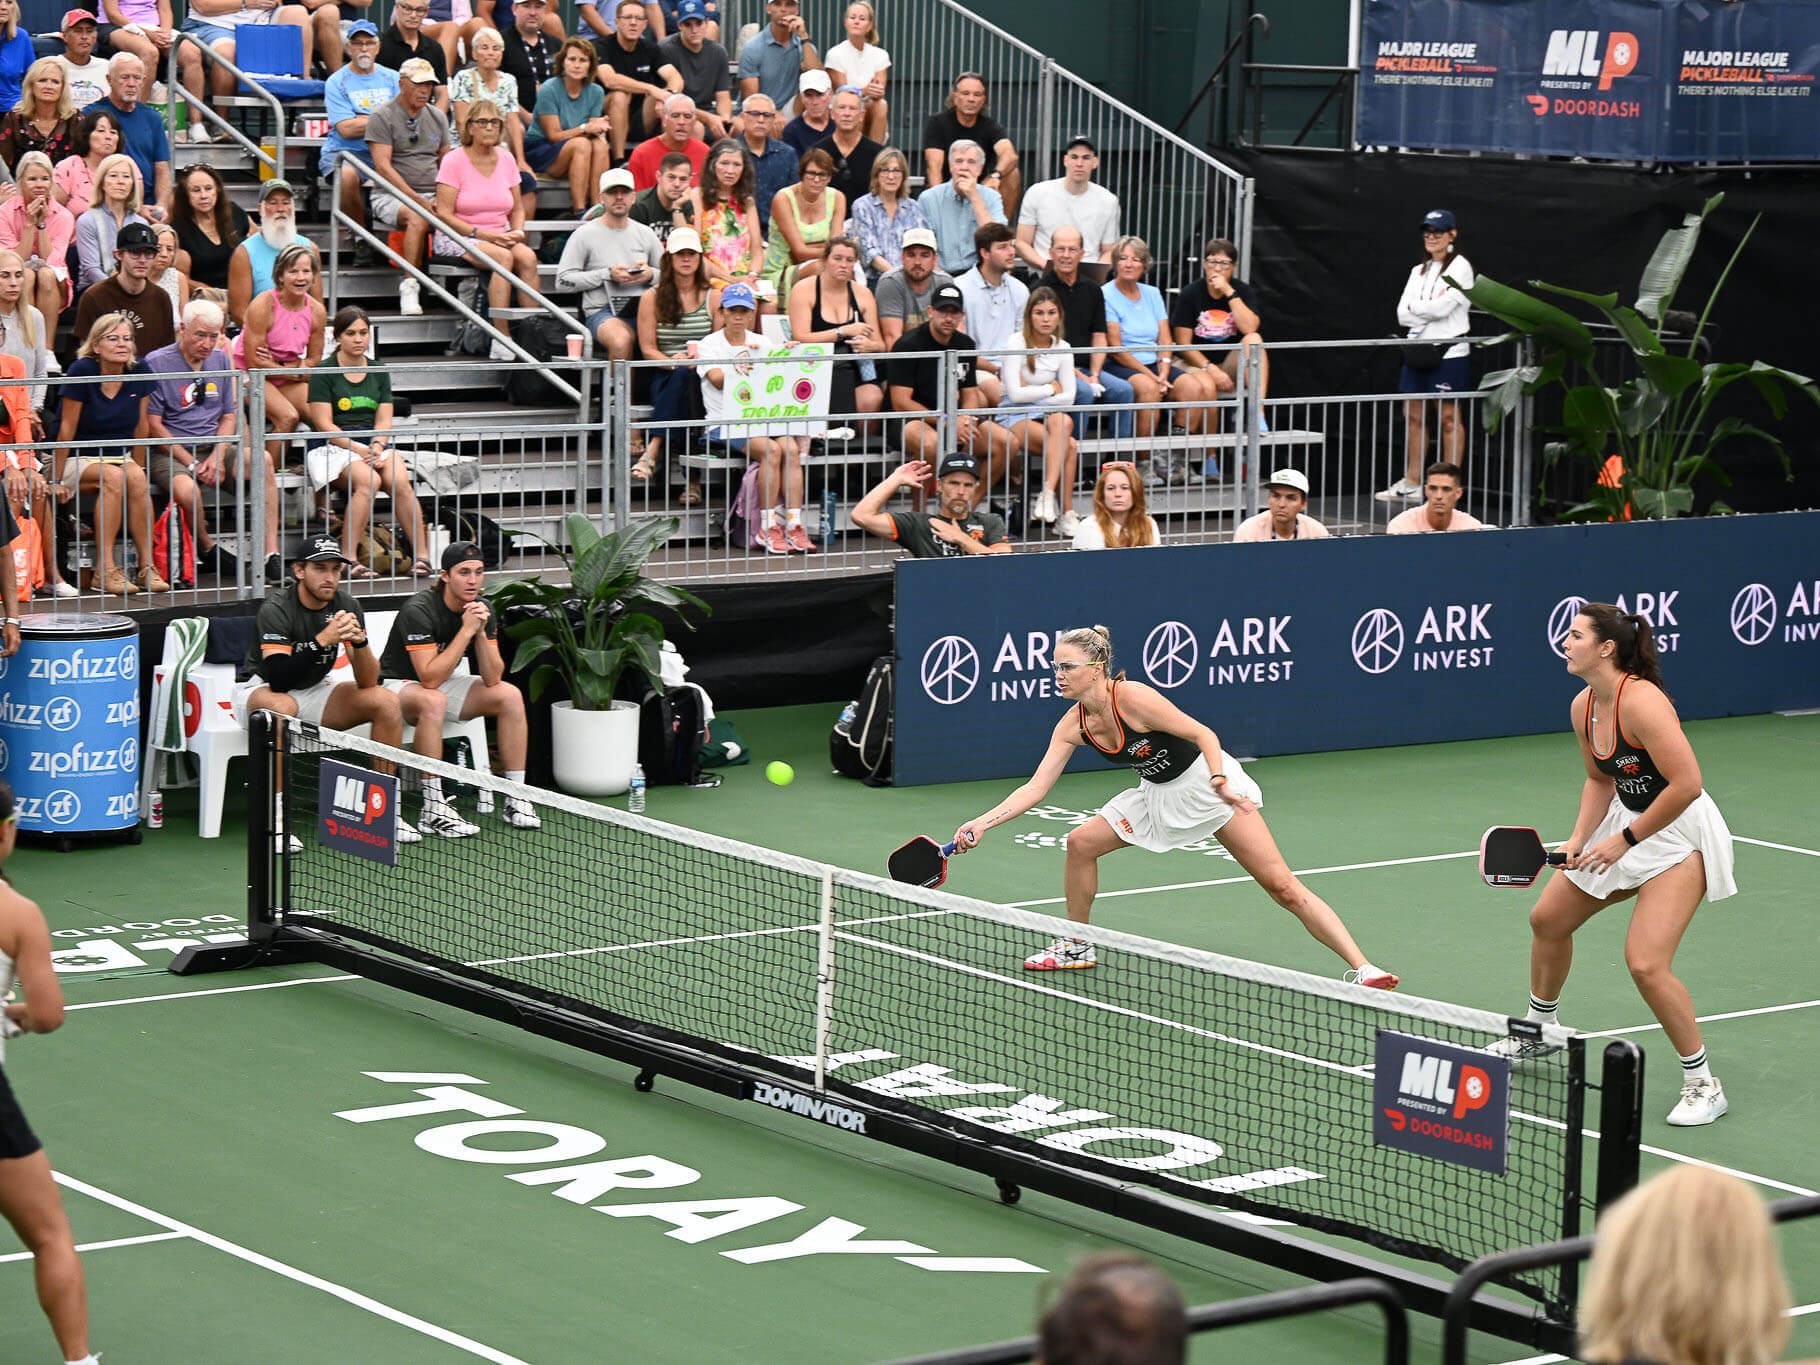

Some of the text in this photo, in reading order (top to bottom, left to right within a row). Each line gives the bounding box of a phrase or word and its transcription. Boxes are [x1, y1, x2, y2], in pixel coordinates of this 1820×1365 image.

[1378, 41, 1477, 58] MAJOR LEAGUE
[1542, 30, 1639, 90] MLP
[1682, 50, 1789, 67] MAJOR LEAGUE
[1376, 57, 1453, 73] PICKLEBALL
[1680, 66, 1764, 82] PICKLEBALL
[1541, 80, 1592, 90] PRESENTED BY
[1715, 85, 1755, 96] NOTHING
[1756, 86, 1777, 96] ELSE
[1778, 86, 1798, 96] LIKE
[1554, 98, 1640, 118] DOORDASH
[1415, 603, 1492, 644] ARK
[1210, 615, 1292, 658] ARK
[992, 630, 1063, 673] AR
[1413, 647, 1494, 671] INVEST
[28, 648, 118, 685] zipfizz
[1208, 661, 1294, 686] INVEST
[1128, 738, 1149, 756] SMASH
[28, 741, 118, 778] zipfizz
[1616, 755, 1639, 769] SMASH
[333, 775, 386, 825] MLP
[339, 825, 389, 848] DOORDASH
[1399, 1052, 1491, 1120] MLP
[753, 1081, 867, 1134] DOMINATOR
[1397, 1097, 1448, 1115] PRESENTED BY
[1410, 1117, 1493, 1151] DOORDASH
